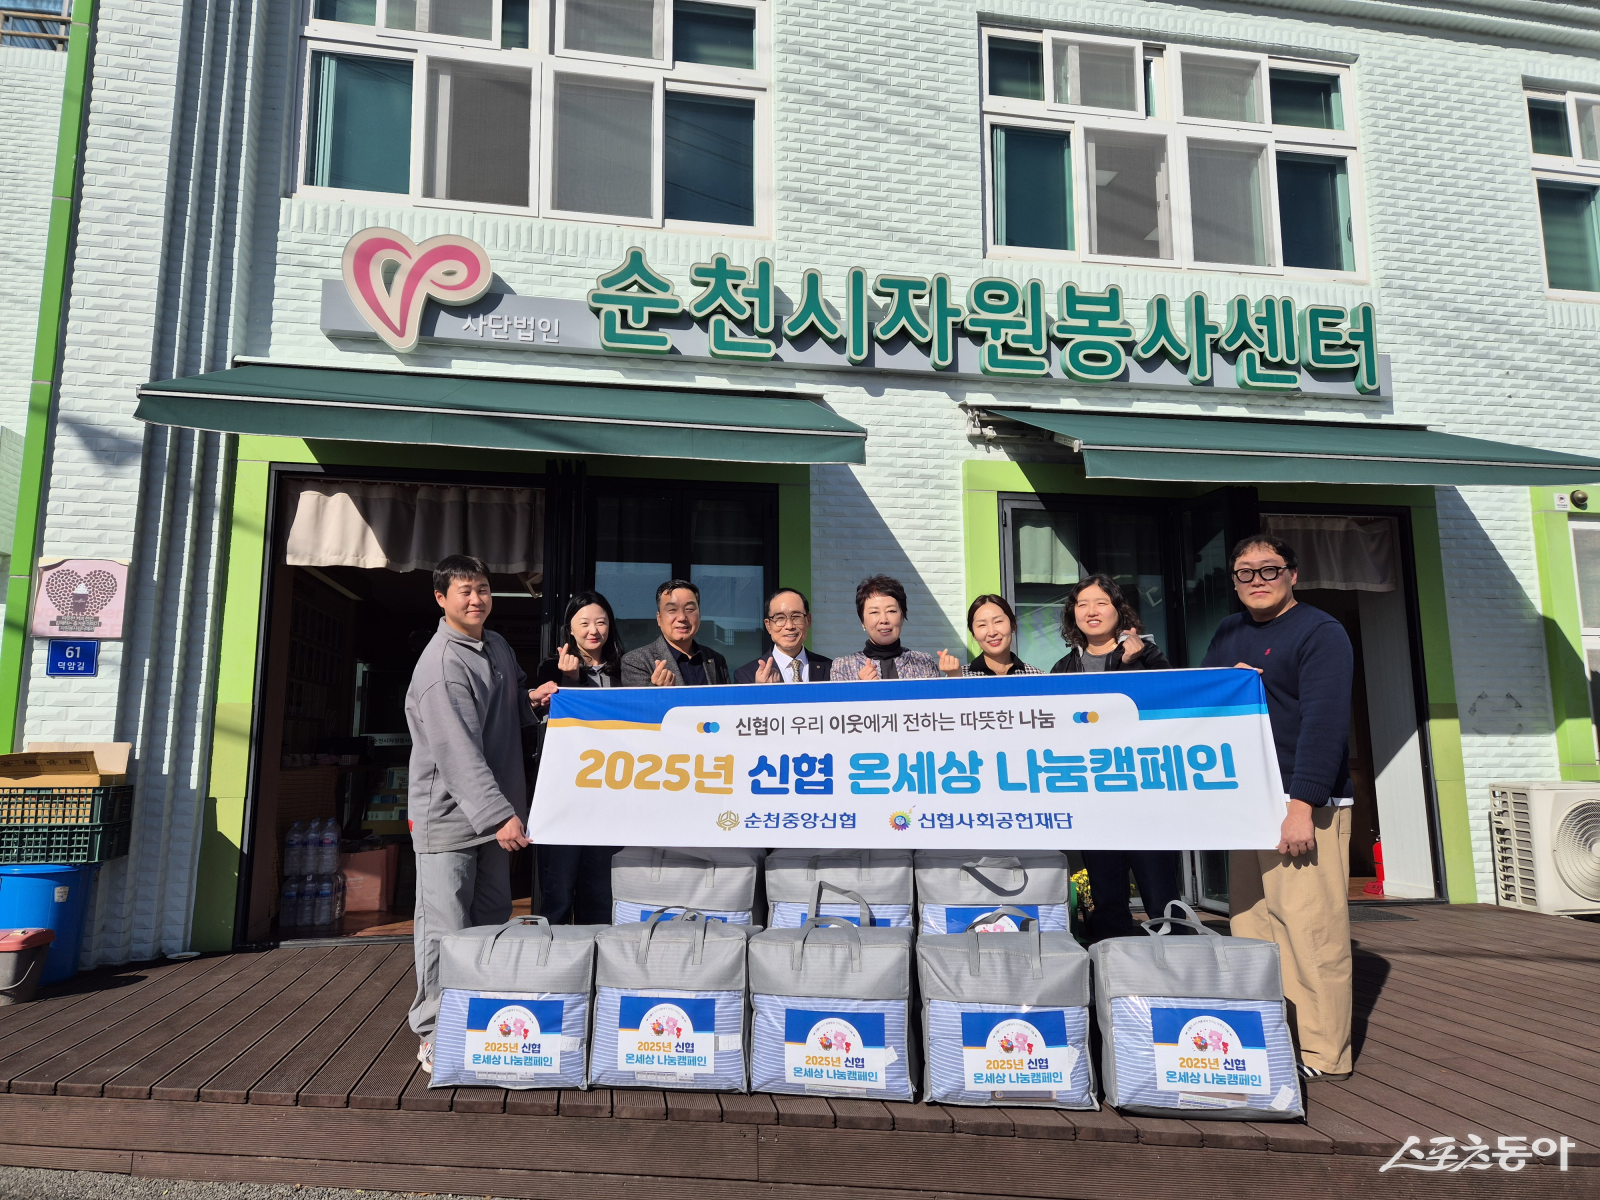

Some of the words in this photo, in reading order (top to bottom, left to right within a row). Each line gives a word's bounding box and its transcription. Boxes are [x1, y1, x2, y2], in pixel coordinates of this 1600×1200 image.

[462, 313, 560, 343] 사단법인
[587, 246, 1379, 393] 순천시자원봉사센터
[66, 646, 80, 658] 61
[58, 661, 85, 671] 덕암길
[735, 716, 786, 736] 신협이
[790, 716, 824, 736] 우리
[829, 713, 898, 734] 이웃에게
[903, 711, 956, 732] 전하는
[960, 709, 1014, 731] 따뜻한
[1020, 708, 1056, 730] 나눔
[575, 749, 735, 795] 2025년
[748, 752, 834, 795] 신협
[848, 750, 984, 795] 온세상
[996, 742, 1239, 794] 나눔캠페인
[744, 812, 856, 830] 순천중앙신협
[918, 812, 1073, 830] 신협사회공헌재단
[484, 1042, 518, 1054] 2025년
[522, 1042, 541, 1054] 신협
[637, 1041, 672, 1053] 2025년
[674, 1042, 694, 1054] 신협
[472, 1054, 501, 1066] 온세상
[504, 1054, 552, 1066] 나눔캠페인
[626, 1053, 654, 1065] 온세상
[657, 1054, 707, 1066] 나눔캠페인
[805, 1055, 841, 1068] 2025년
[844, 1056, 865, 1069] 신협
[985, 1058, 1024, 1070] 2025년
[1027, 1058, 1049, 1070] 신협
[1178, 1057, 1220, 1070] 2025년
[1223, 1058, 1246, 1071] 신협
[793, 1066, 824, 1078] 온세상
[826, 1069, 878, 1082] 나눔캠페인
[973, 1072, 1006, 1084] 온세상
[1009, 1072, 1063, 1084] 나눔캠페인
[1166, 1070, 1201, 1084] 온세상
[1204, 1073, 1262, 1086] 나눔캠페인
